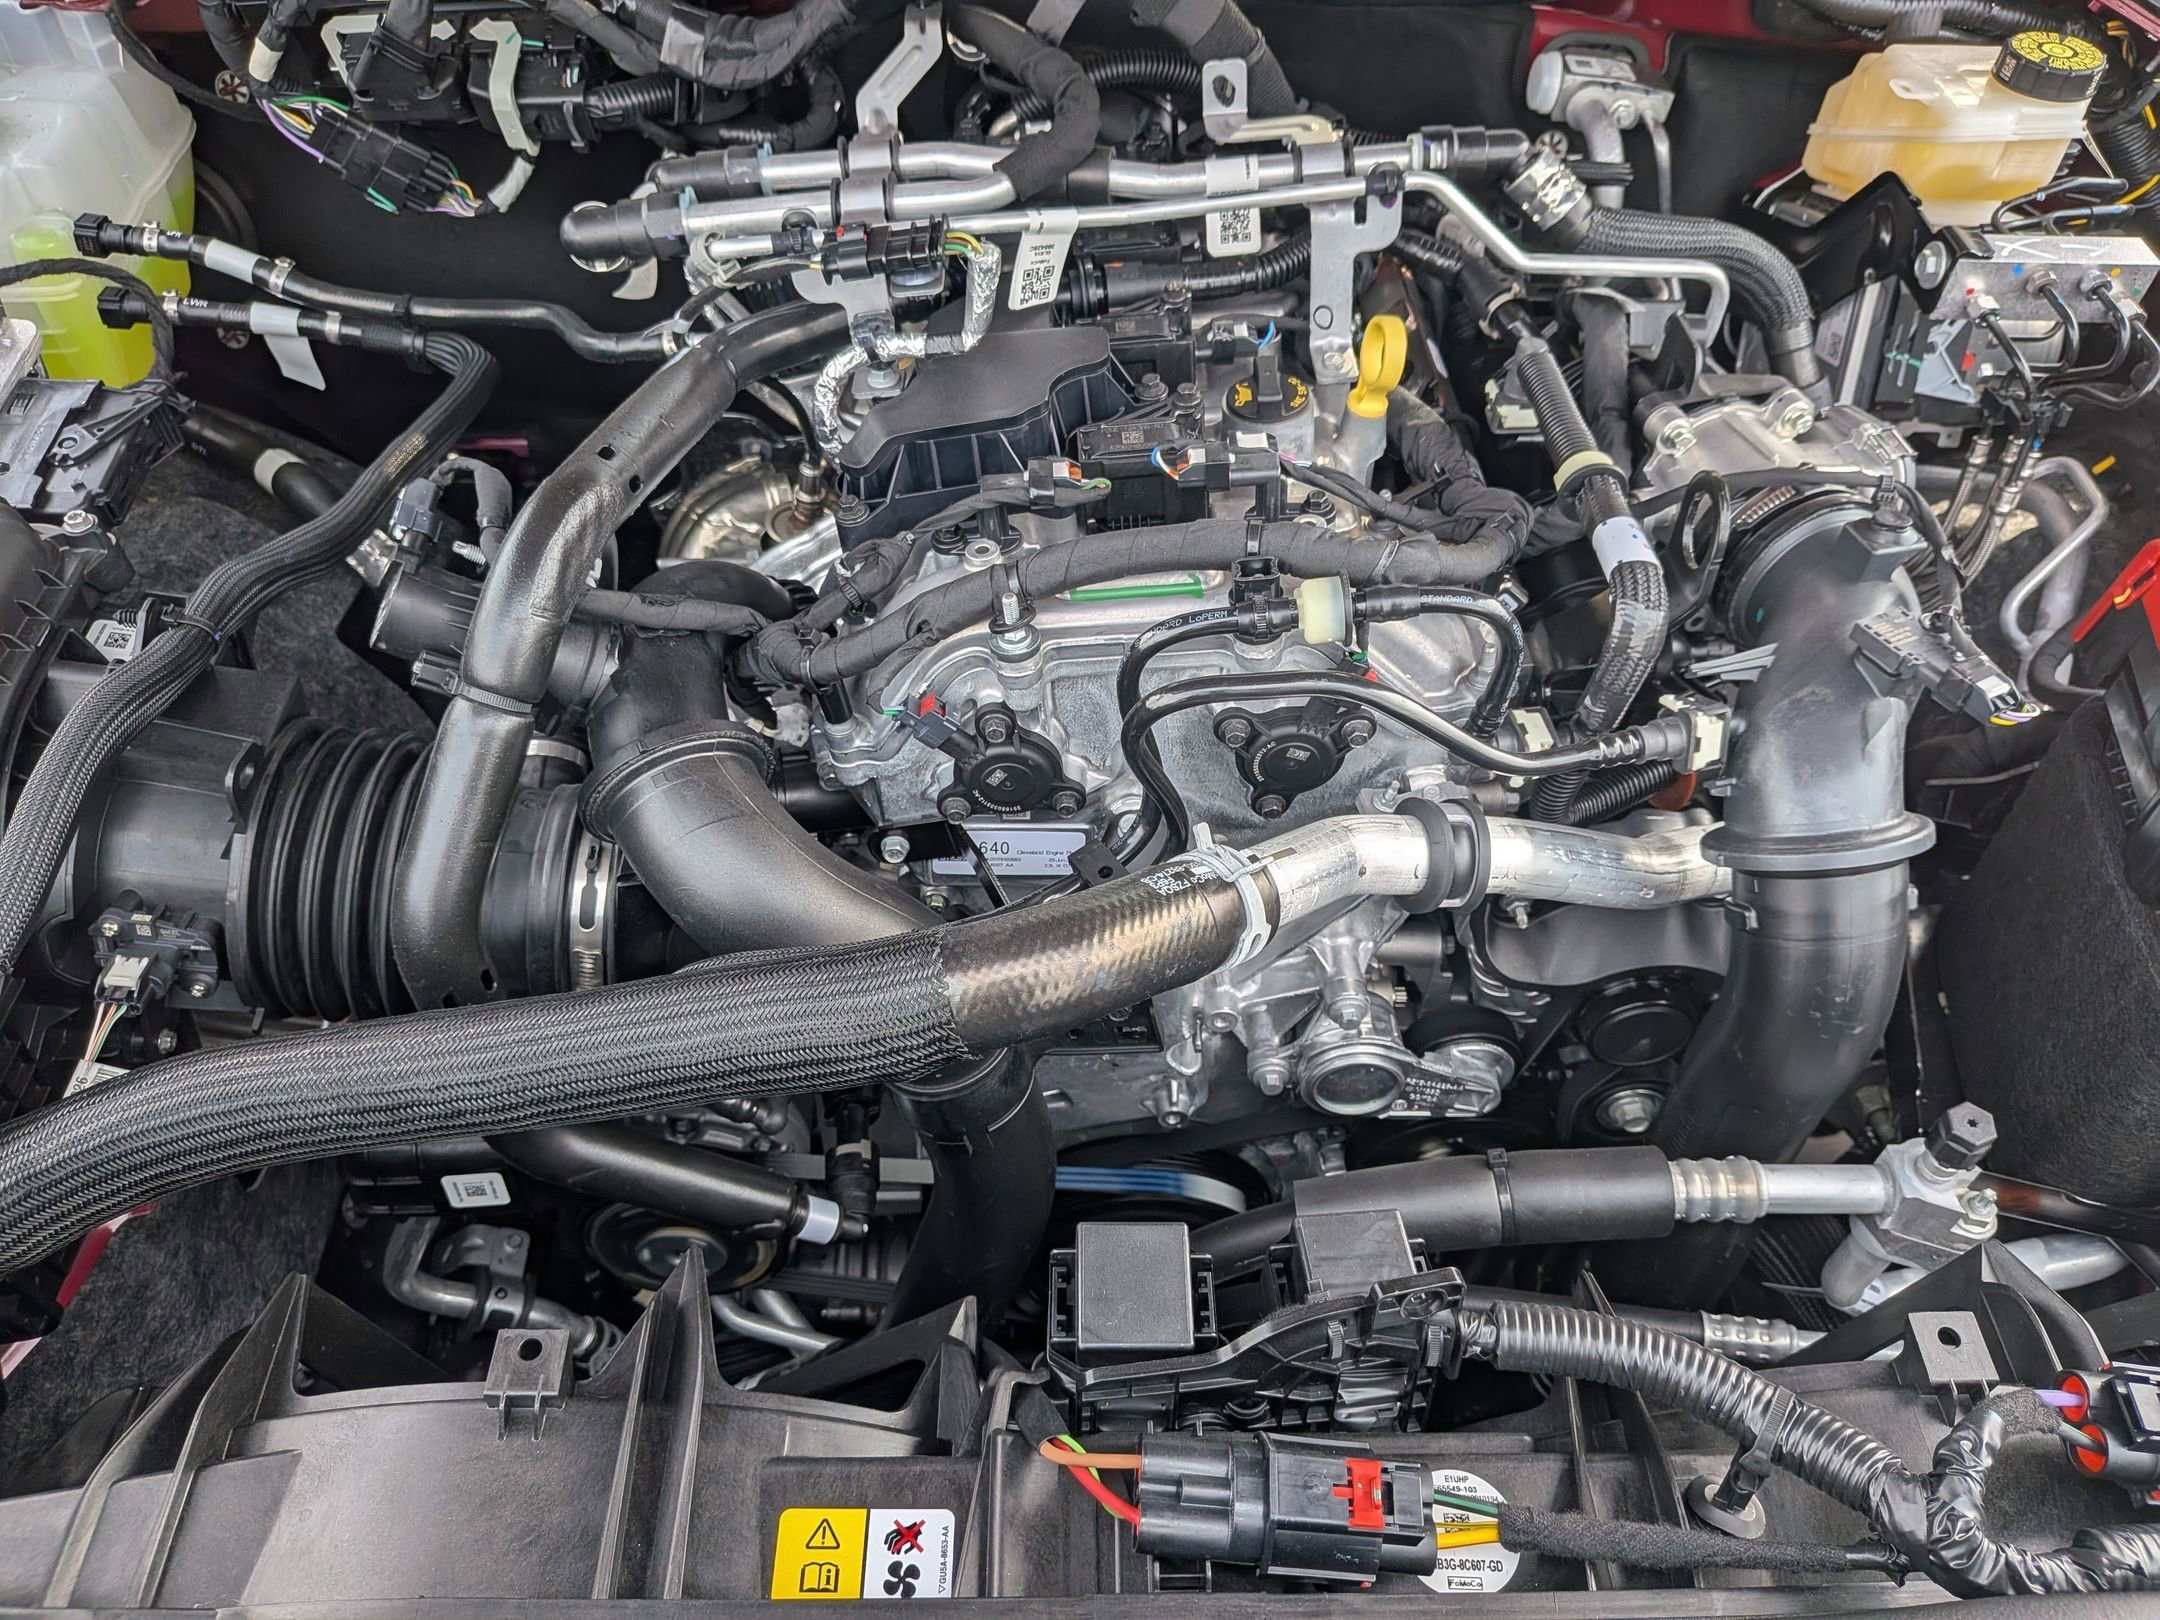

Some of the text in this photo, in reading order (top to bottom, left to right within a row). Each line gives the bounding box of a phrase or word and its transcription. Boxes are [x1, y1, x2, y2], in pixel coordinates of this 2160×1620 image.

[1420, 594, 1474, 604] STANDARD
[1188, 610, 1228, 623] LoPERM
[1435, 1557, 1504, 1573] B3G-8C607-GD
